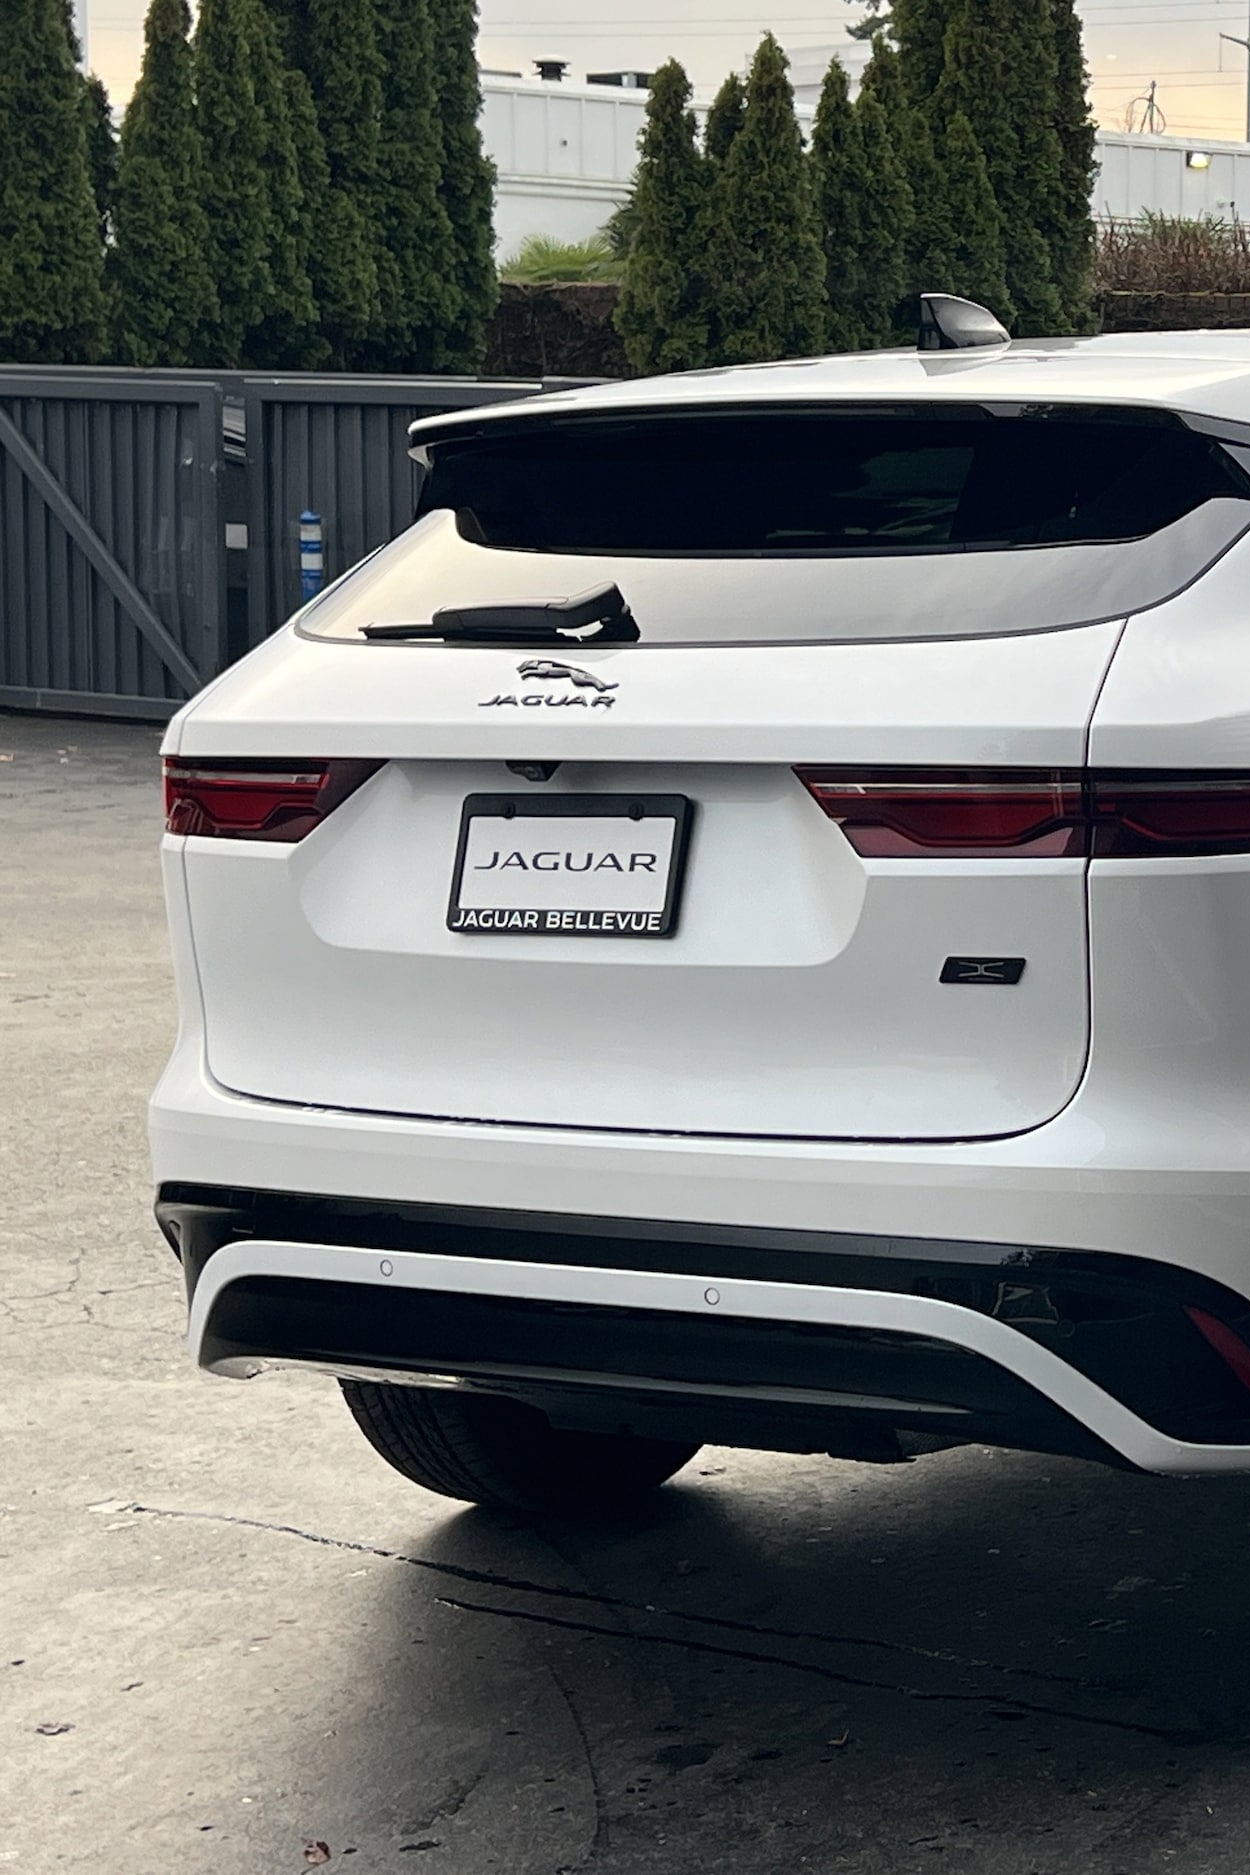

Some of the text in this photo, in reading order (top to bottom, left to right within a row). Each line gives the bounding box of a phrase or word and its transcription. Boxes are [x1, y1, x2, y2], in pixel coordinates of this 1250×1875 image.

[478, 694, 617, 708] JAGUAR
[474, 851, 657, 872] JAGUAR
[452, 909, 662, 931] JAGUAR BELLEVUE
